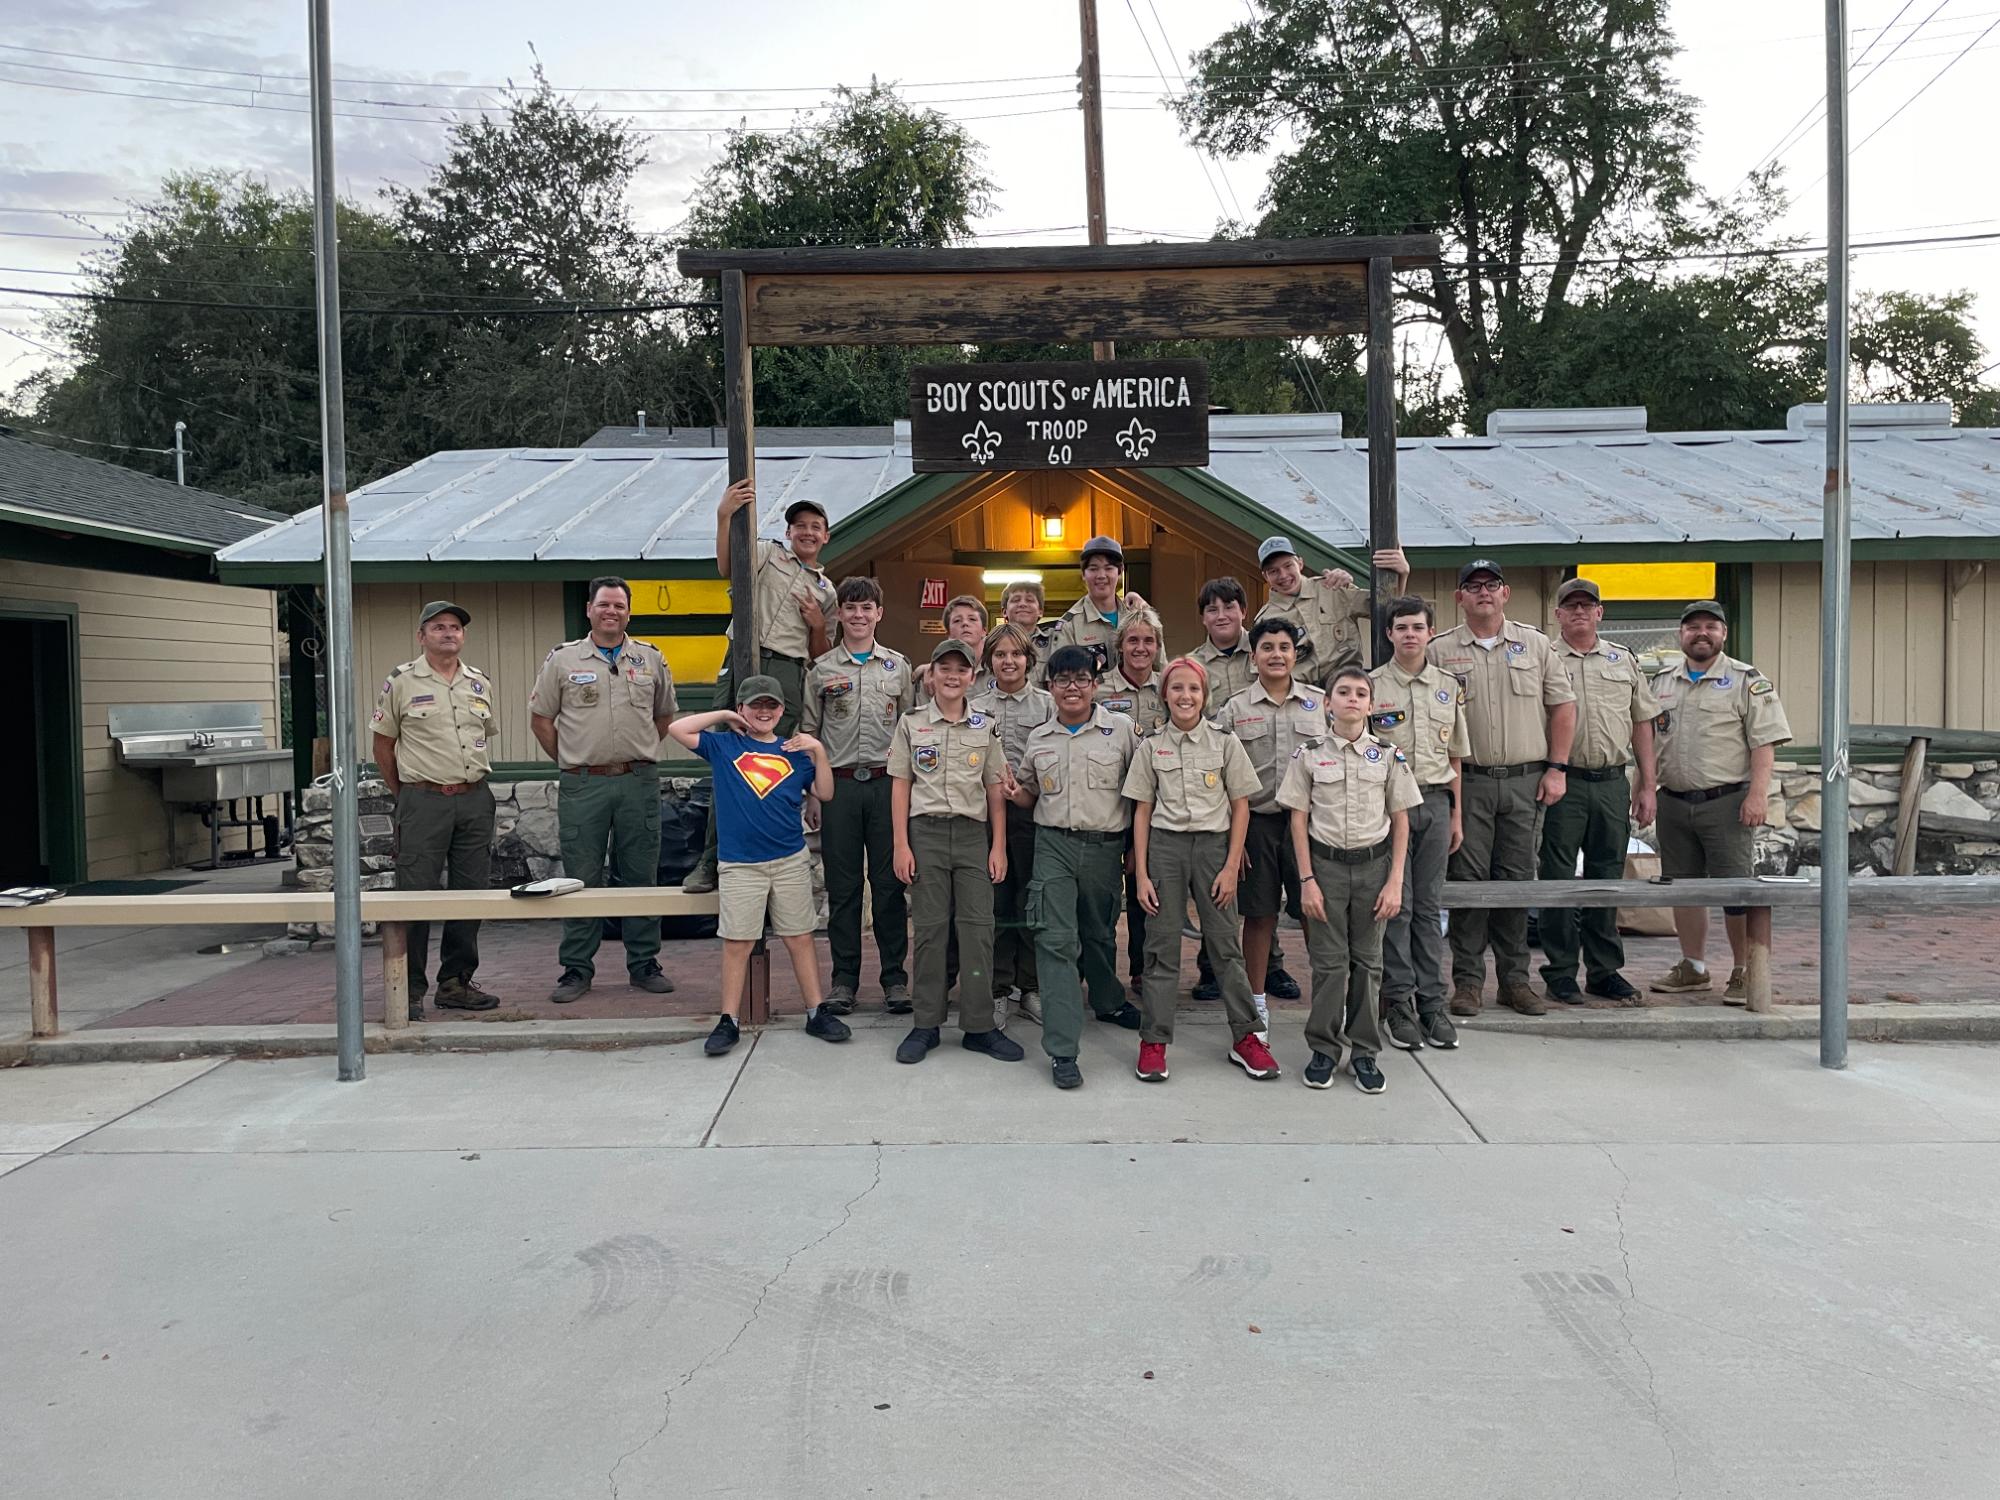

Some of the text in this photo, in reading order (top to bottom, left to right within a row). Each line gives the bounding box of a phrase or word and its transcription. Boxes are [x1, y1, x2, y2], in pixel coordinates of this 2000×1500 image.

[927, 376, 1191, 413] BOY SCOUTS OF AMERICA
[1026, 419, 1088, 441] TROOP
[1047, 445, 1072, 465] 60
[923, 581, 945, 605] EXIT
